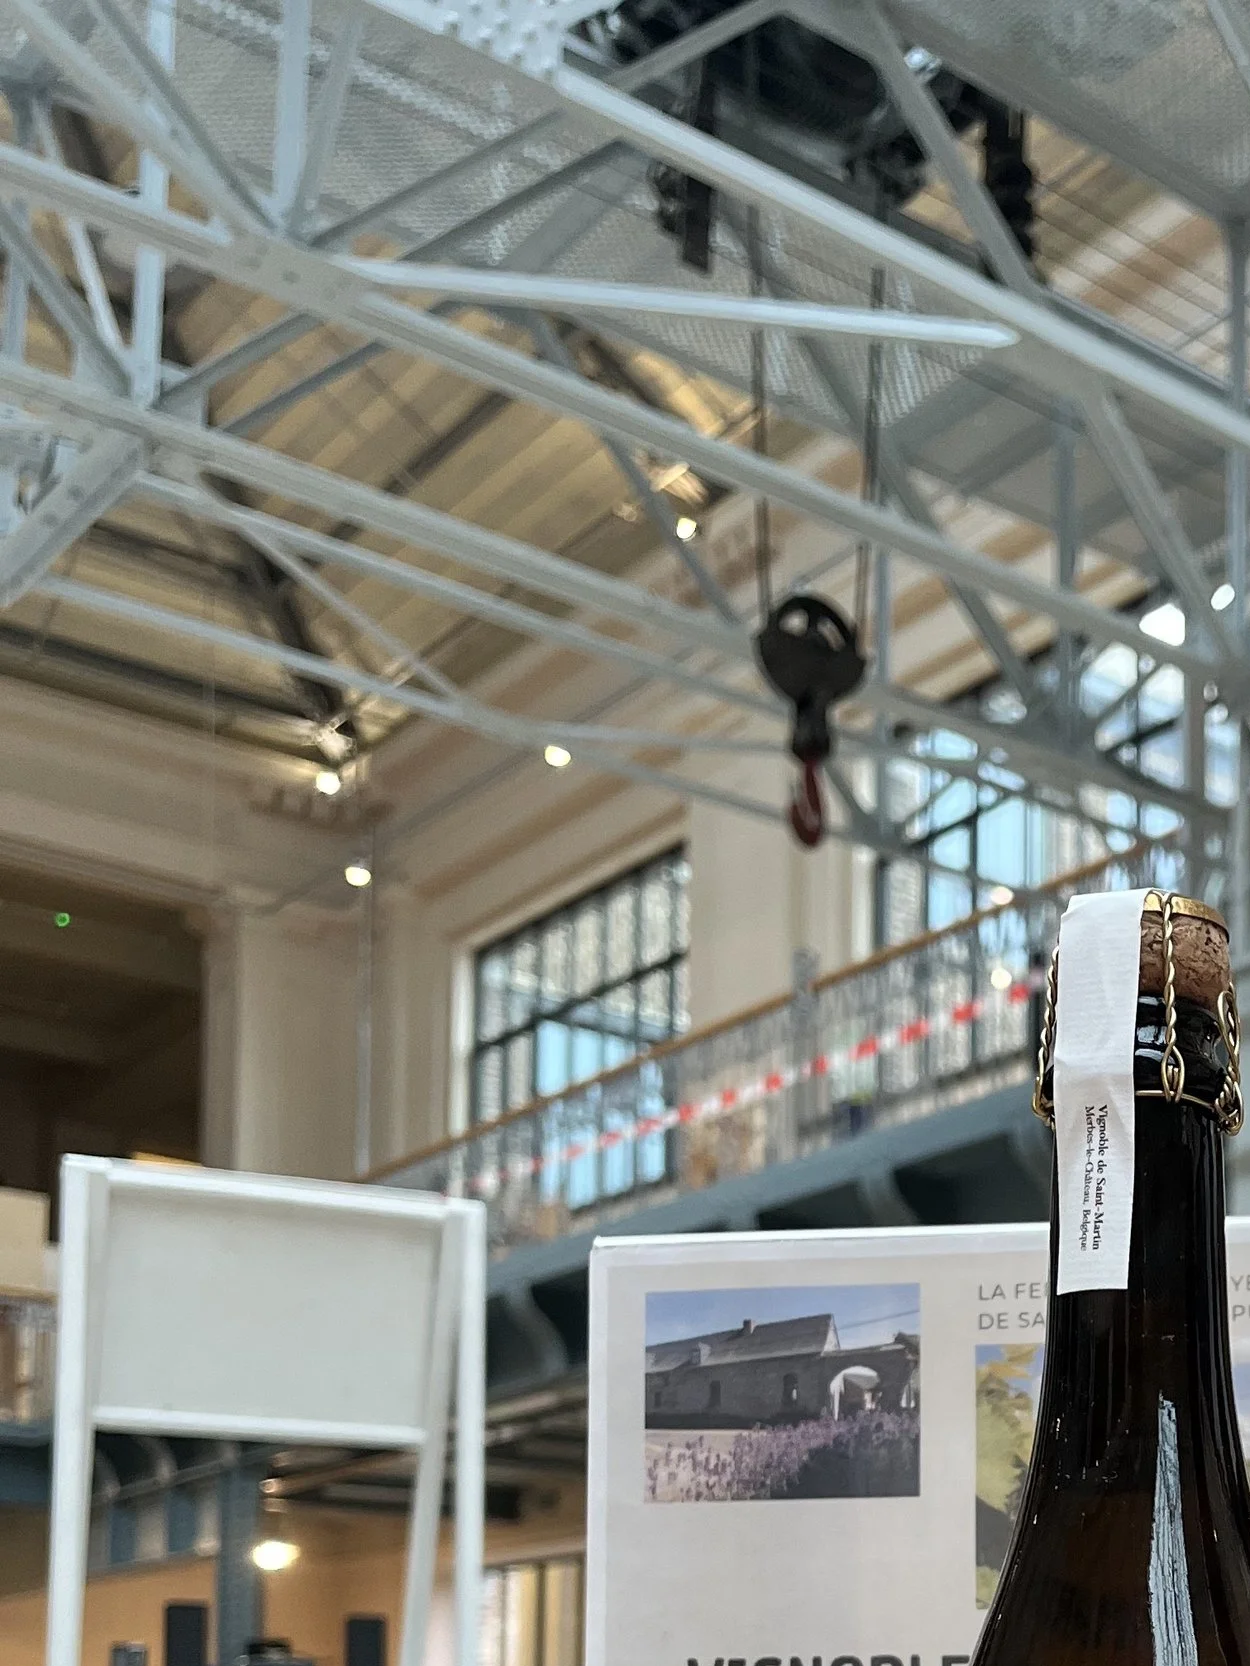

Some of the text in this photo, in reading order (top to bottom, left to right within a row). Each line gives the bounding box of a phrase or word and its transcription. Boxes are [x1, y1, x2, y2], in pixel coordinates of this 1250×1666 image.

[1092, 1104, 1109, 1250] Vignoble de Saint-Martin
[979, 1283, 1006, 1301] LA
[1015, 1282, 1047, 1300] FE
[979, 1312, 1009, 1330] DE
